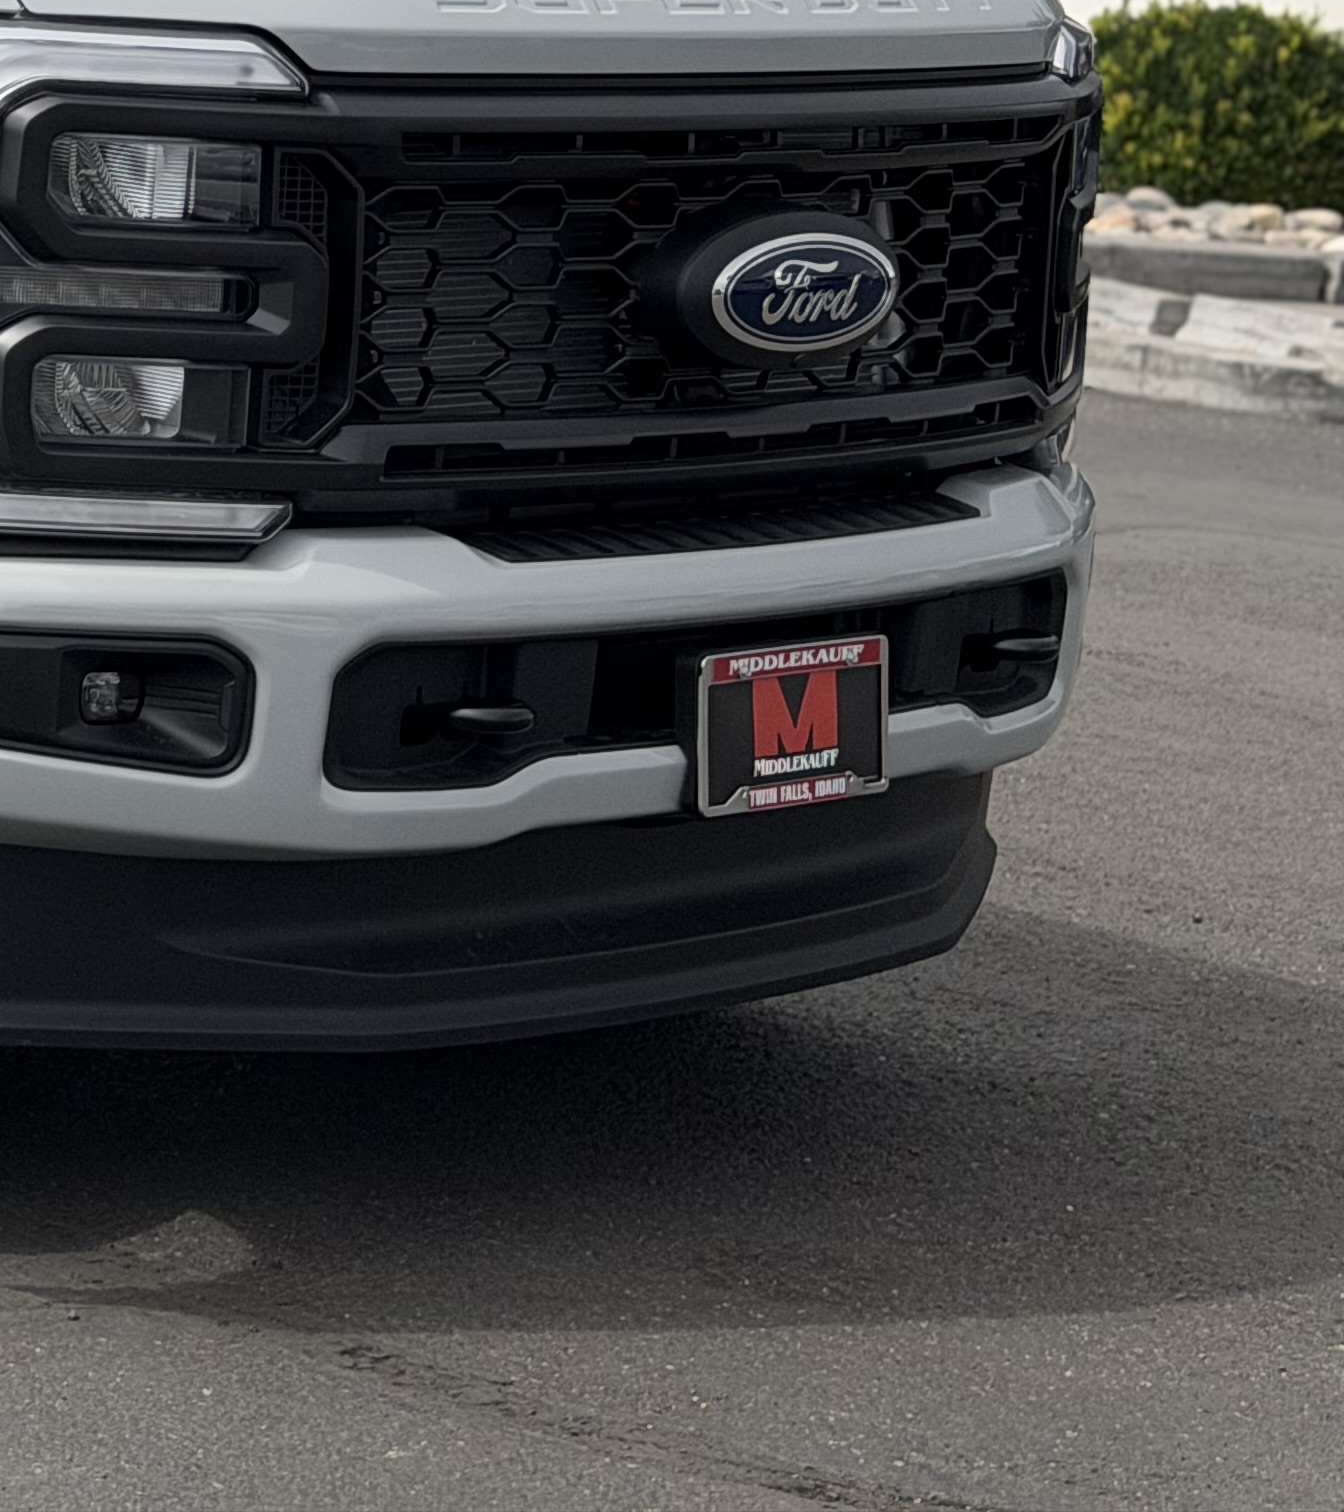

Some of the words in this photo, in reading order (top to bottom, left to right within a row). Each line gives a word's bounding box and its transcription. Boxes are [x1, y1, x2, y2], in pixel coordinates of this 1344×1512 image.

[761, 259, 862, 326] Ford
[752, 669, 839, 758] M
[753, 748, 839, 778] MIDDLEKAUFF
[749, 788, 777, 808] TWIN
[815, 776, 846, 798] IDAHO
